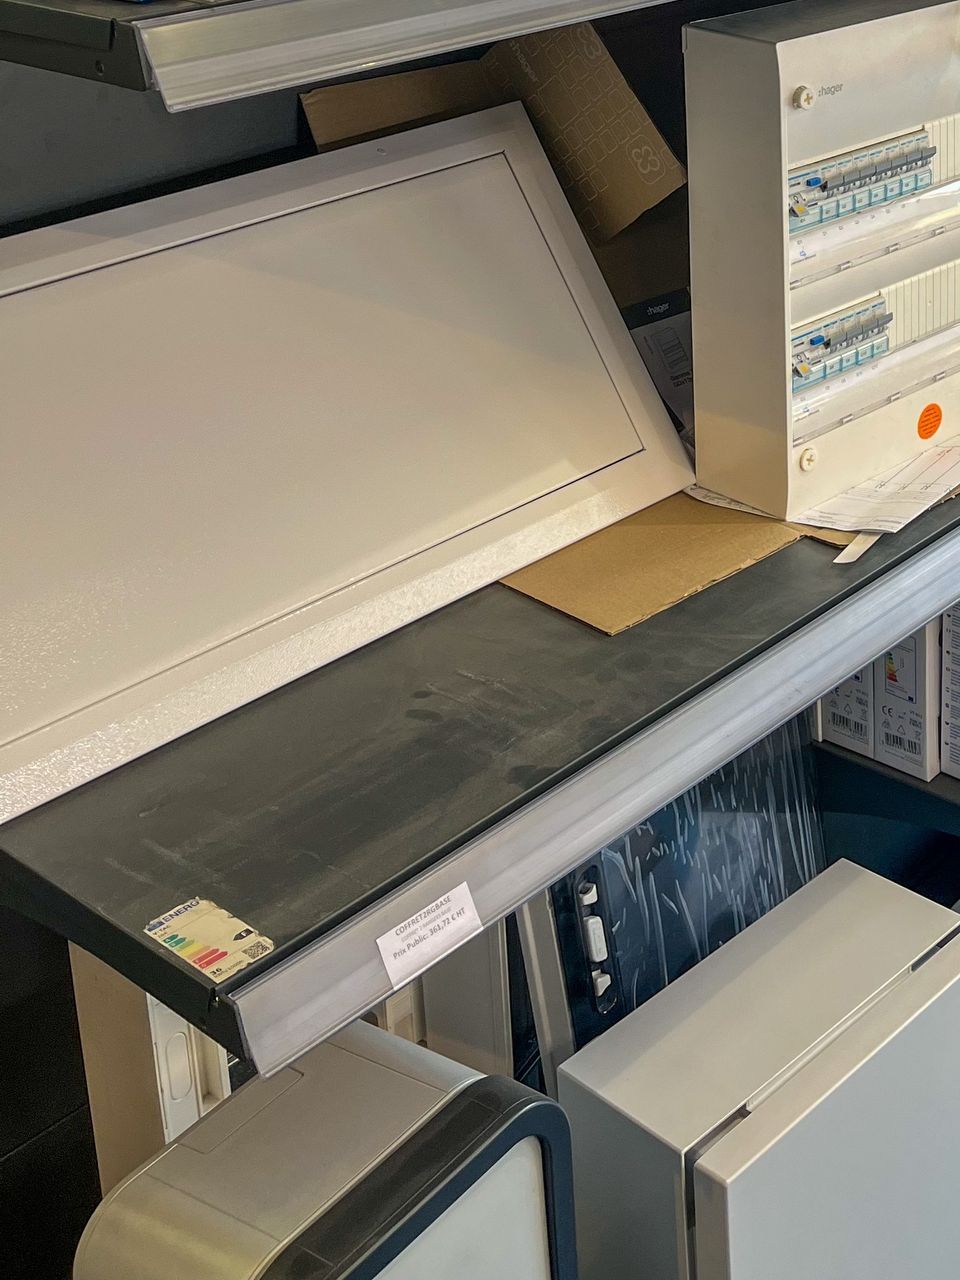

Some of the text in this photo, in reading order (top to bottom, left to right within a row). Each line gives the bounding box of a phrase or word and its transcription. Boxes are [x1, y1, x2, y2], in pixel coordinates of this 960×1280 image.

[162, 900, 200, 923] ENERG
[394, 895, 451, 936] COFFRET2RGBASE
[392, 948, 407, 960] Prix
[406, 933, 430, 951] Public:
[429, 919, 451, 937] 361,72
[456, 907, 466, 918] HT
[209, 967, 223, 977] 36
